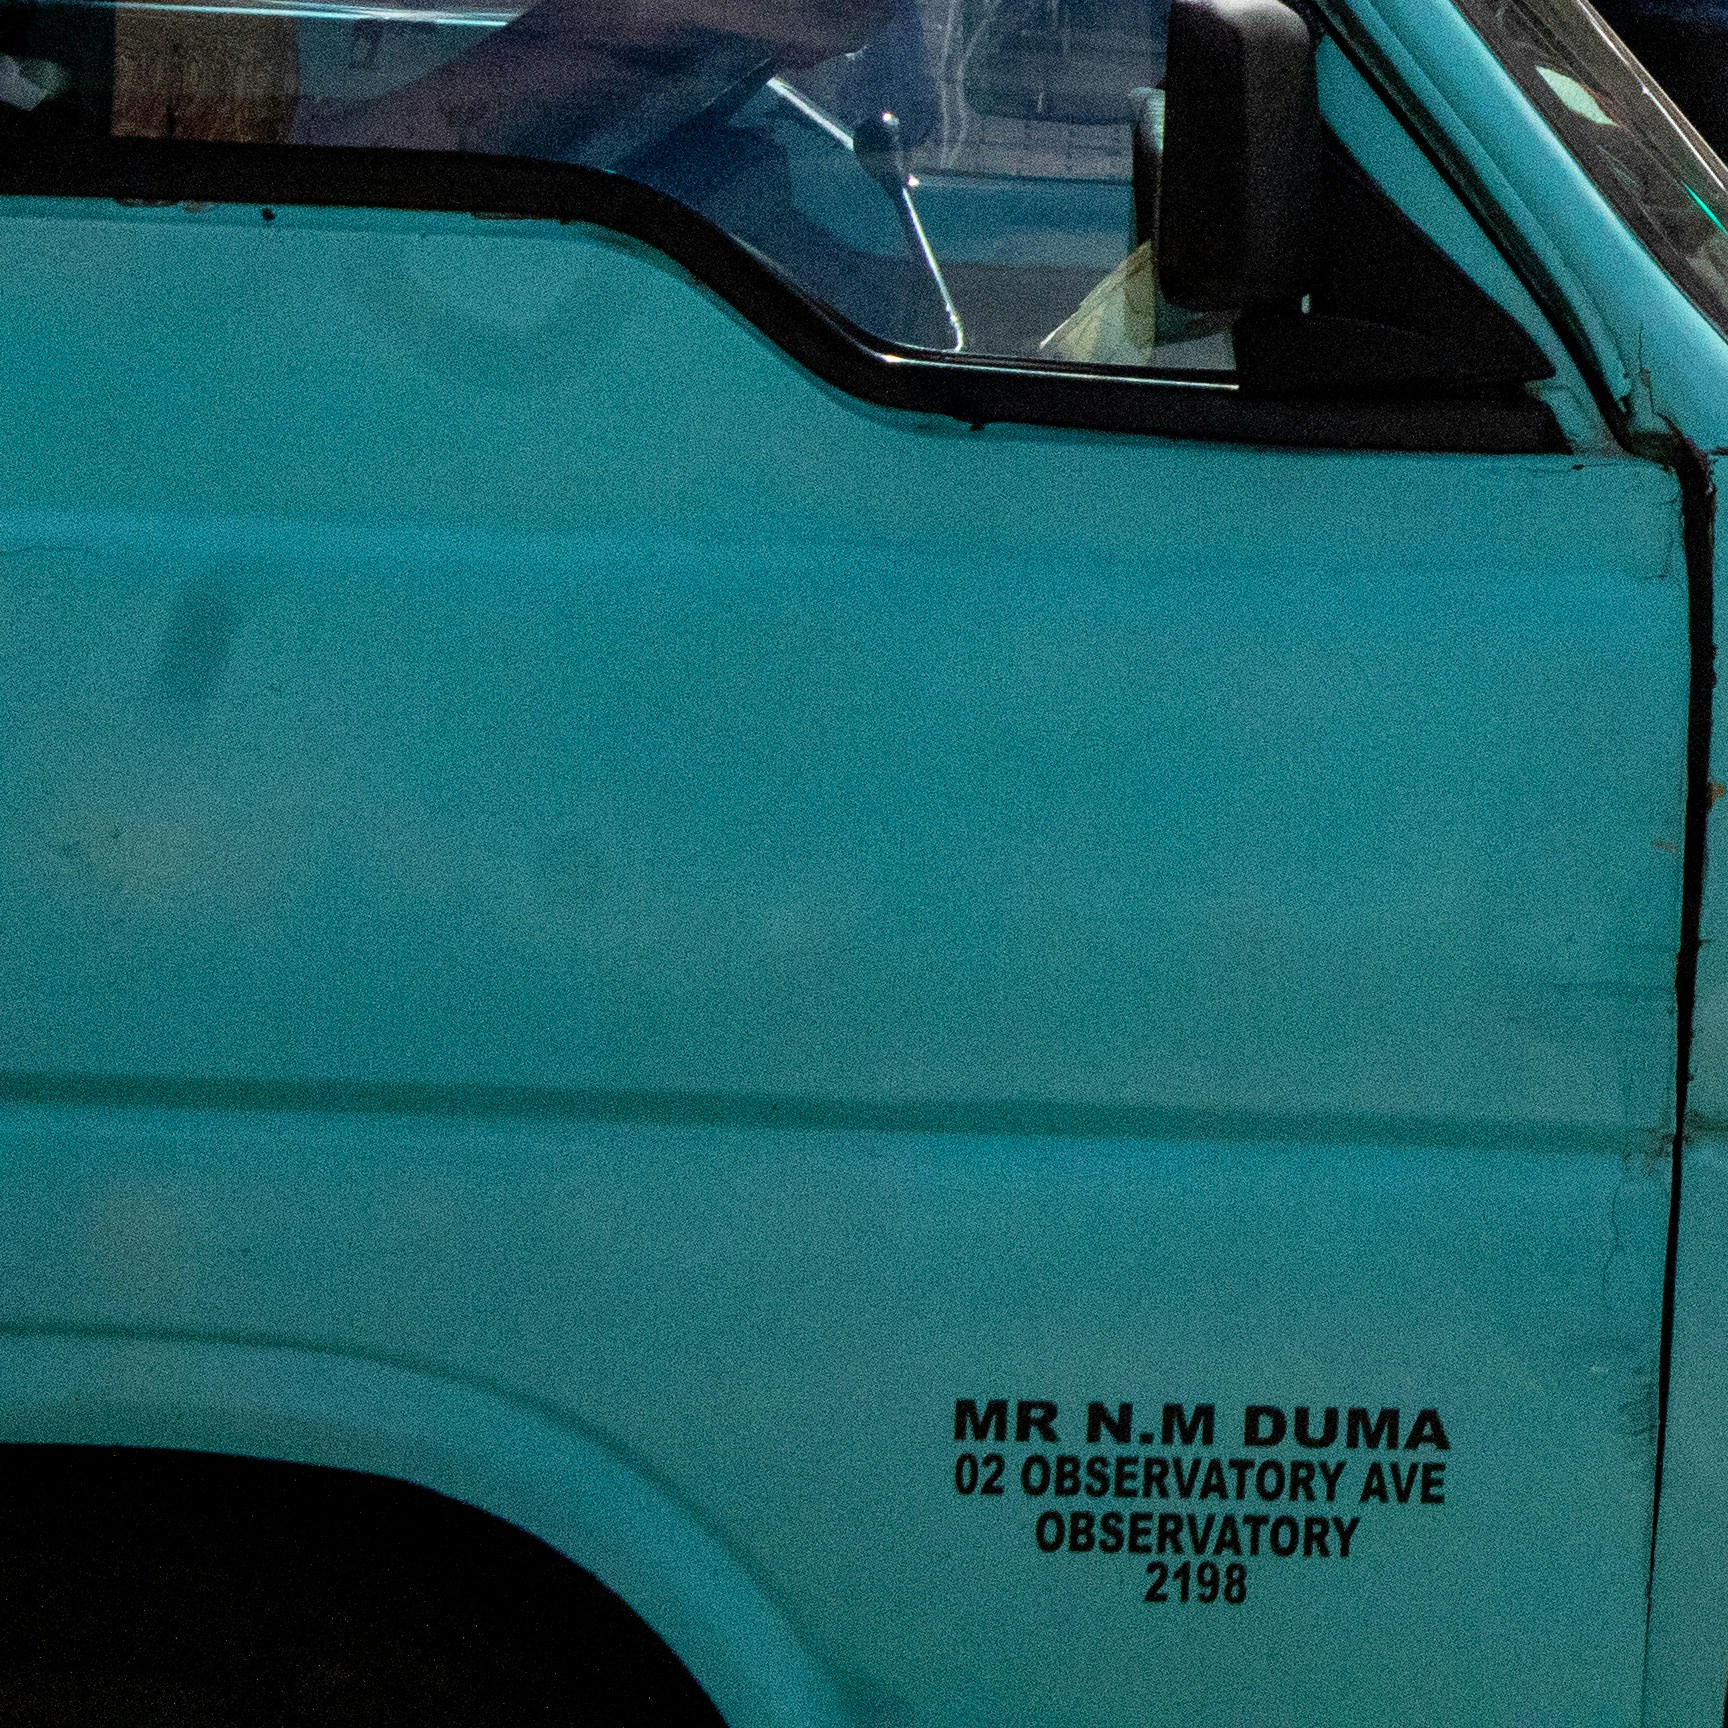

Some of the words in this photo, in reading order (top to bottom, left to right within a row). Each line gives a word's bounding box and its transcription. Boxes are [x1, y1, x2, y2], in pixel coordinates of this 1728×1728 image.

[953, 1398, 1060, 1444] MR
[1086, 1400, 1215, 1446] N.M
[1243, 1404, 1451, 1451] DUMA
[954, 1452, 1006, 1496] 02
[1020, 1454, 1348, 1502] OBSERVATORY
[1360, 1461, 1446, 1505] AVE
[1035, 1510, 1361, 1558] OBSERVATORY
[1144, 1560, 1248, 1605] 2198
